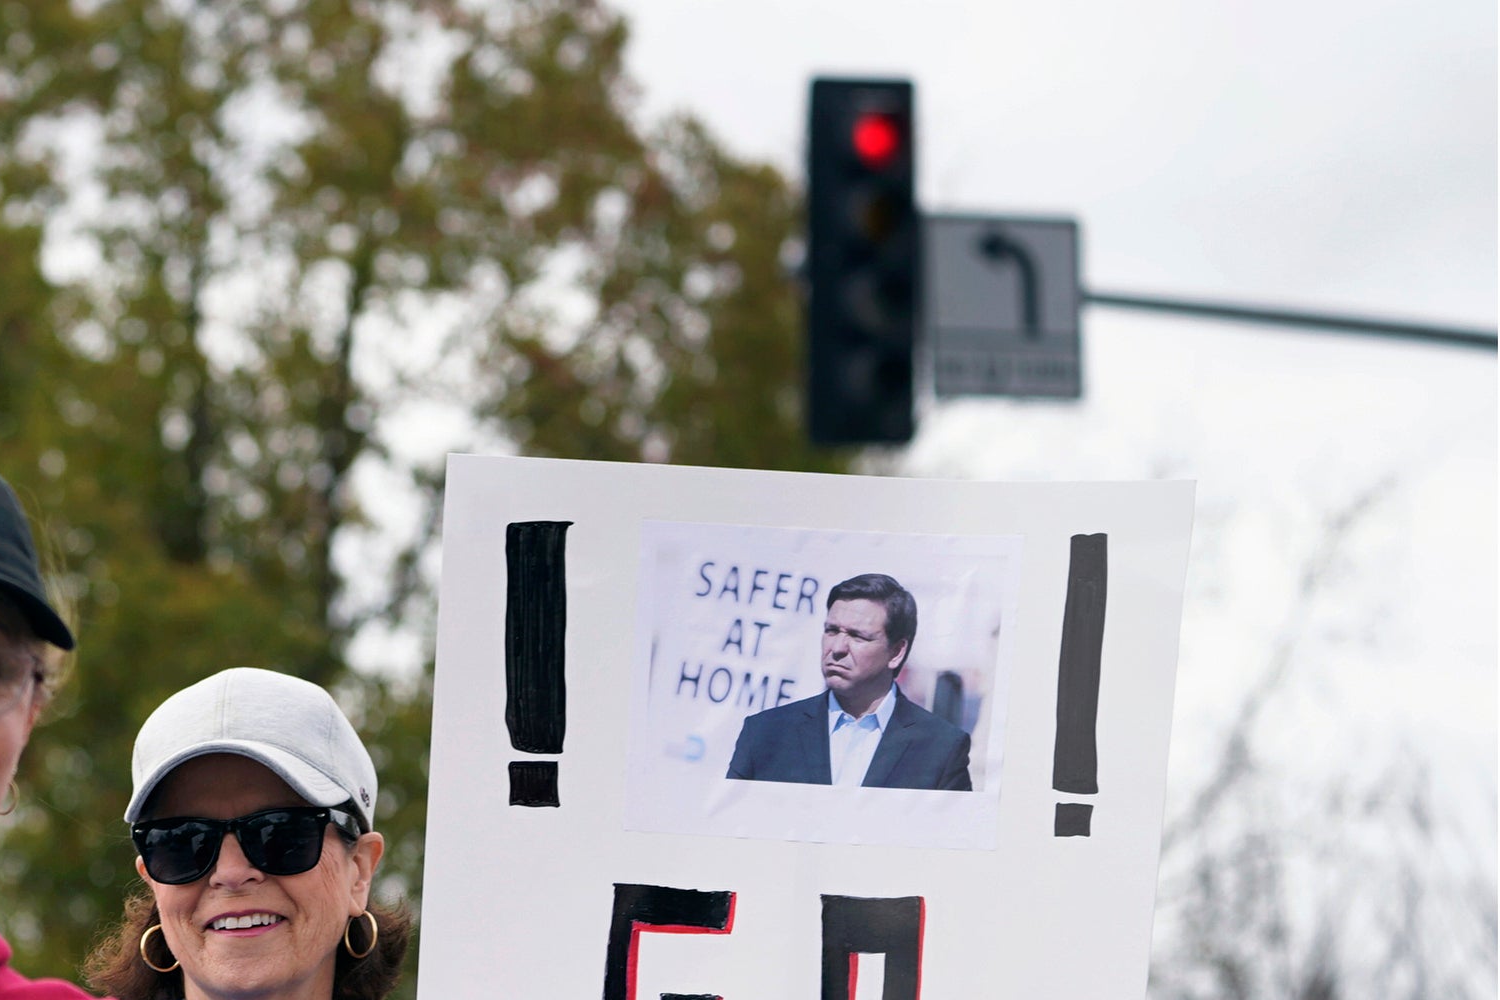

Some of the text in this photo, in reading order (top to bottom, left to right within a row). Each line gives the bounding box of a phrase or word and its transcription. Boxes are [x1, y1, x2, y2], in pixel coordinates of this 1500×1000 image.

[695, 561, 820, 615] SAFER
[721, 618, 770, 657] AT
[675, 661, 795, 707] HOME
